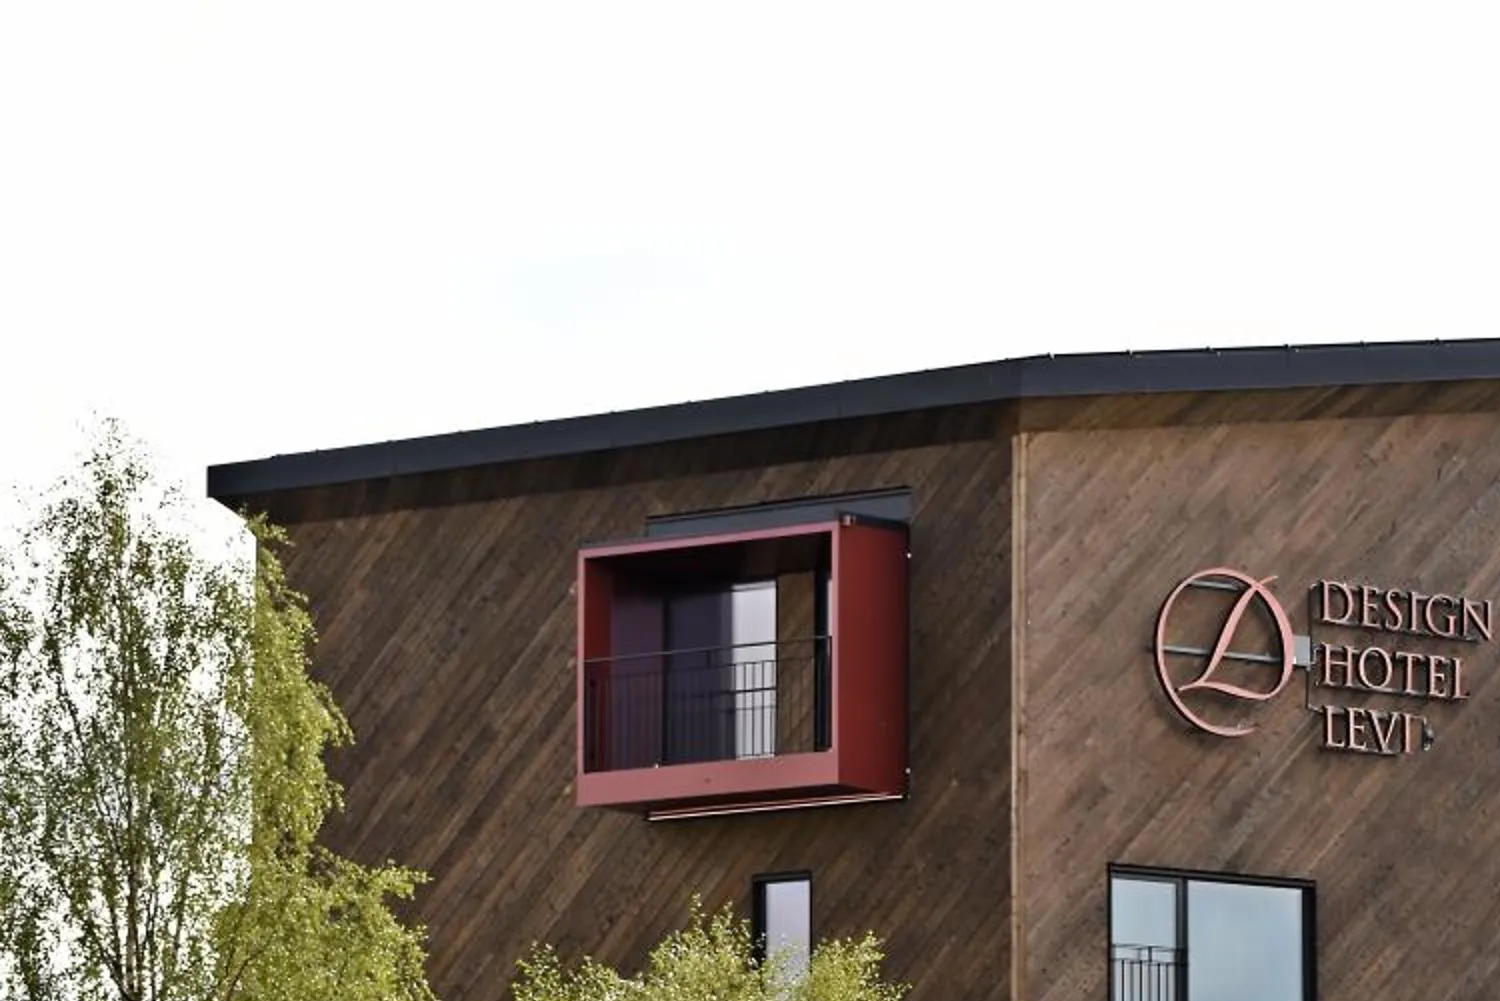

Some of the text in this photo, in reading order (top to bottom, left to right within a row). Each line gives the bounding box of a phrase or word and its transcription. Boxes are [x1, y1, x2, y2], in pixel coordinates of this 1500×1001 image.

[1321, 579, 1494, 642] DESIGN
[1321, 642, 1472, 700] HOTEL
[1323, 705, 1417, 754] LEVI
